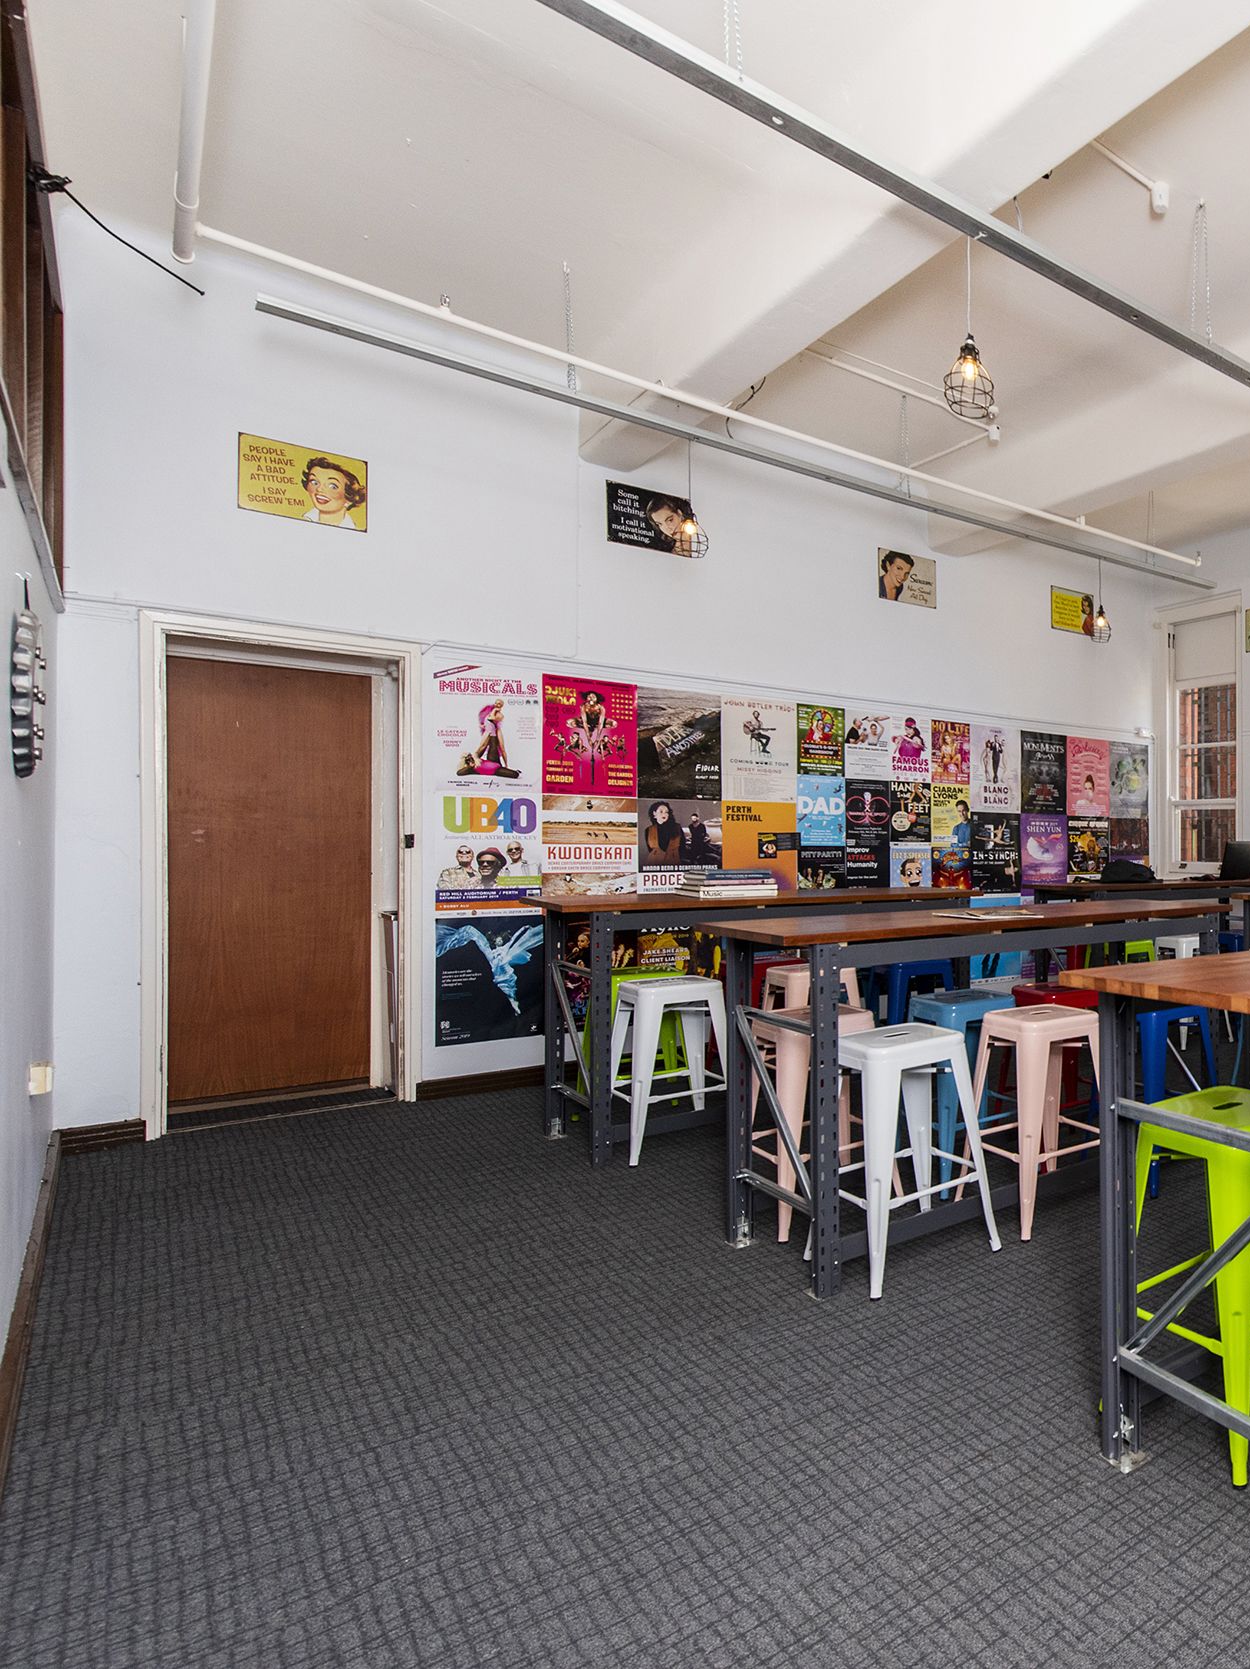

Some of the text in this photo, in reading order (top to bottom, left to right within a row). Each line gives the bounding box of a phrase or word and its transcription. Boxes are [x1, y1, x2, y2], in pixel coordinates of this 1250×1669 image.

[249, 445, 286, 457] PEOPLE
[243, 453, 262, 462] SAY
[270, 457, 295, 467] HAVE
[266, 466, 286, 475] BAD
[250, 473, 298, 485] ATTITUDE.
[268, 487, 287, 495] SAY
[618, 489, 639, 500] Some
[248, 494, 283, 504] SCREW
[633, 500, 639, 508] it
[626, 519, 639, 527] call
[612, 523, 654, 536] motivational
[440, 680, 537, 695] MUSICALS
[747, 702, 772, 710] BUTLER
[892, 756, 929, 766] FAMOUS
[696, 764, 719, 772] FIDLAR
[892, 764, 929, 773] SHARRON
[546, 775, 574, 783] GARDEN
[933, 786, 963, 794] CIARAN
[983, 786, 1008, 794] BLANC
[983, 796, 1008, 805] BLANC
[797, 796, 845, 815] DAD
[908, 803, 930, 813] FEET
[443, 796, 537, 834] UB40
[726, 814, 762, 822] FESTIVAL
[548, 846, 632, 860] KWONGKAN
[973, 851, 1018, 860] IN-SYNCH:
[847, 861, 878, 869] Humanity
